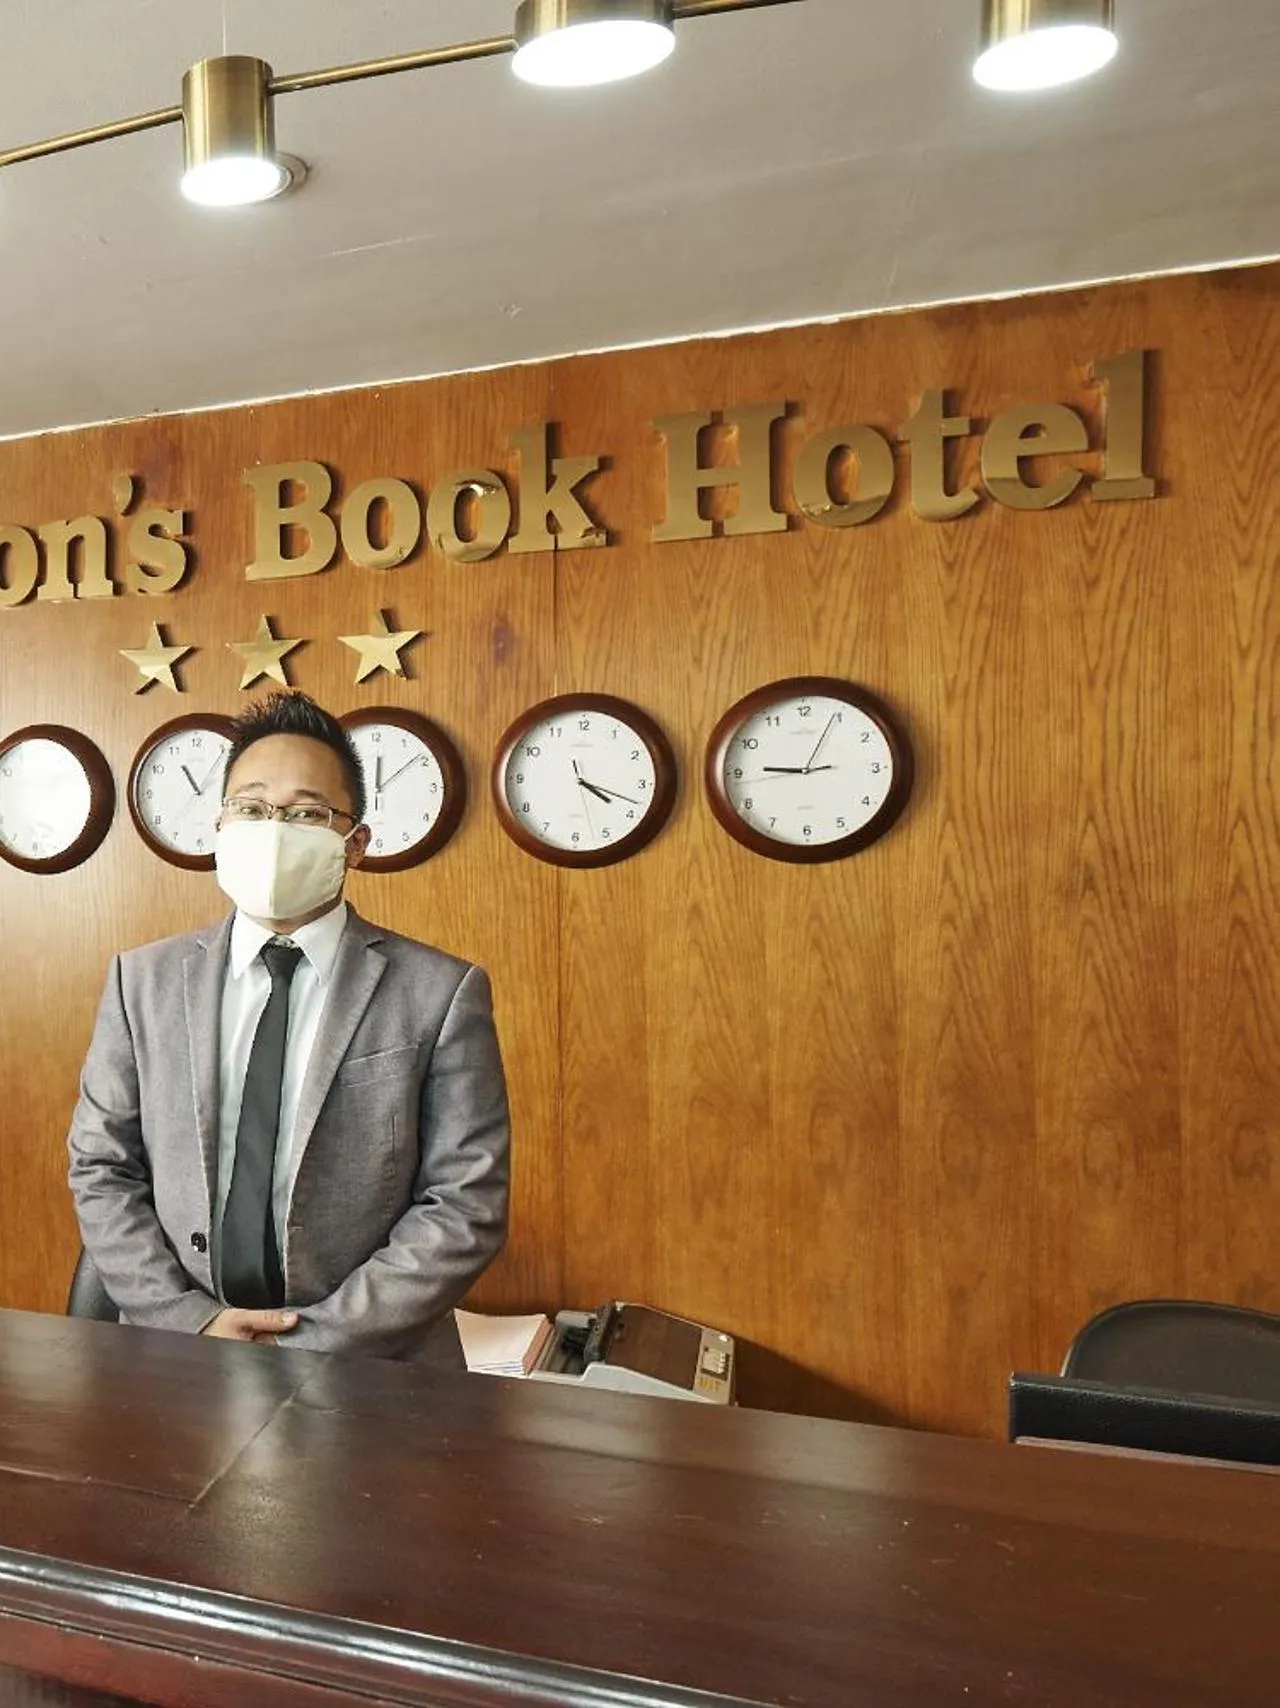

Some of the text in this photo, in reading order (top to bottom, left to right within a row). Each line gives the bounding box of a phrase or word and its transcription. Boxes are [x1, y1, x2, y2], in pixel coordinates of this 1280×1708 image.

[244, 421, 610, 582] Book
[650, 347, 1160, 545] Hotel
[797, 706, 811, 717] 12
[578, 720, 590, 731] 12
[766, 716, 780, 726] 11
[550, 728, 562, 737] 11
[612, 730, 617, 739] 1
[191, 738, 202, 747] 12
[371, 733, 381, 743] 12
[861, 733, 869, 743] 2
[742, 739, 758, 749] 10
[170, 747, 180, 755] 11
[527, 747, 540, 757] 10
[631, 751, 639, 760] 2
[421, 756, 429, 766] 2
[734, 768, 743, 778] 9
[872, 763, 880, 773] 3
[516, 774, 524, 784] 9
[430, 783, 438, 793] 3
[638, 780, 646, 789] 3
[745, 799, 752, 809] 8
[862, 797, 870, 805] 4
[523, 803, 530, 813] 8
[626, 810, 634, 819] 4
[542, 823, 550, 832] 7
[769, 818, 776, 828] 7
[836, 818, 845, 828] 5
[173, 832, 178, 840] 7
[602, 828, 610, 838] 5
[803, 826, 811, 836] 6
[572, 833, 579, 842] 6
[376, 839, 383, 847] 6
